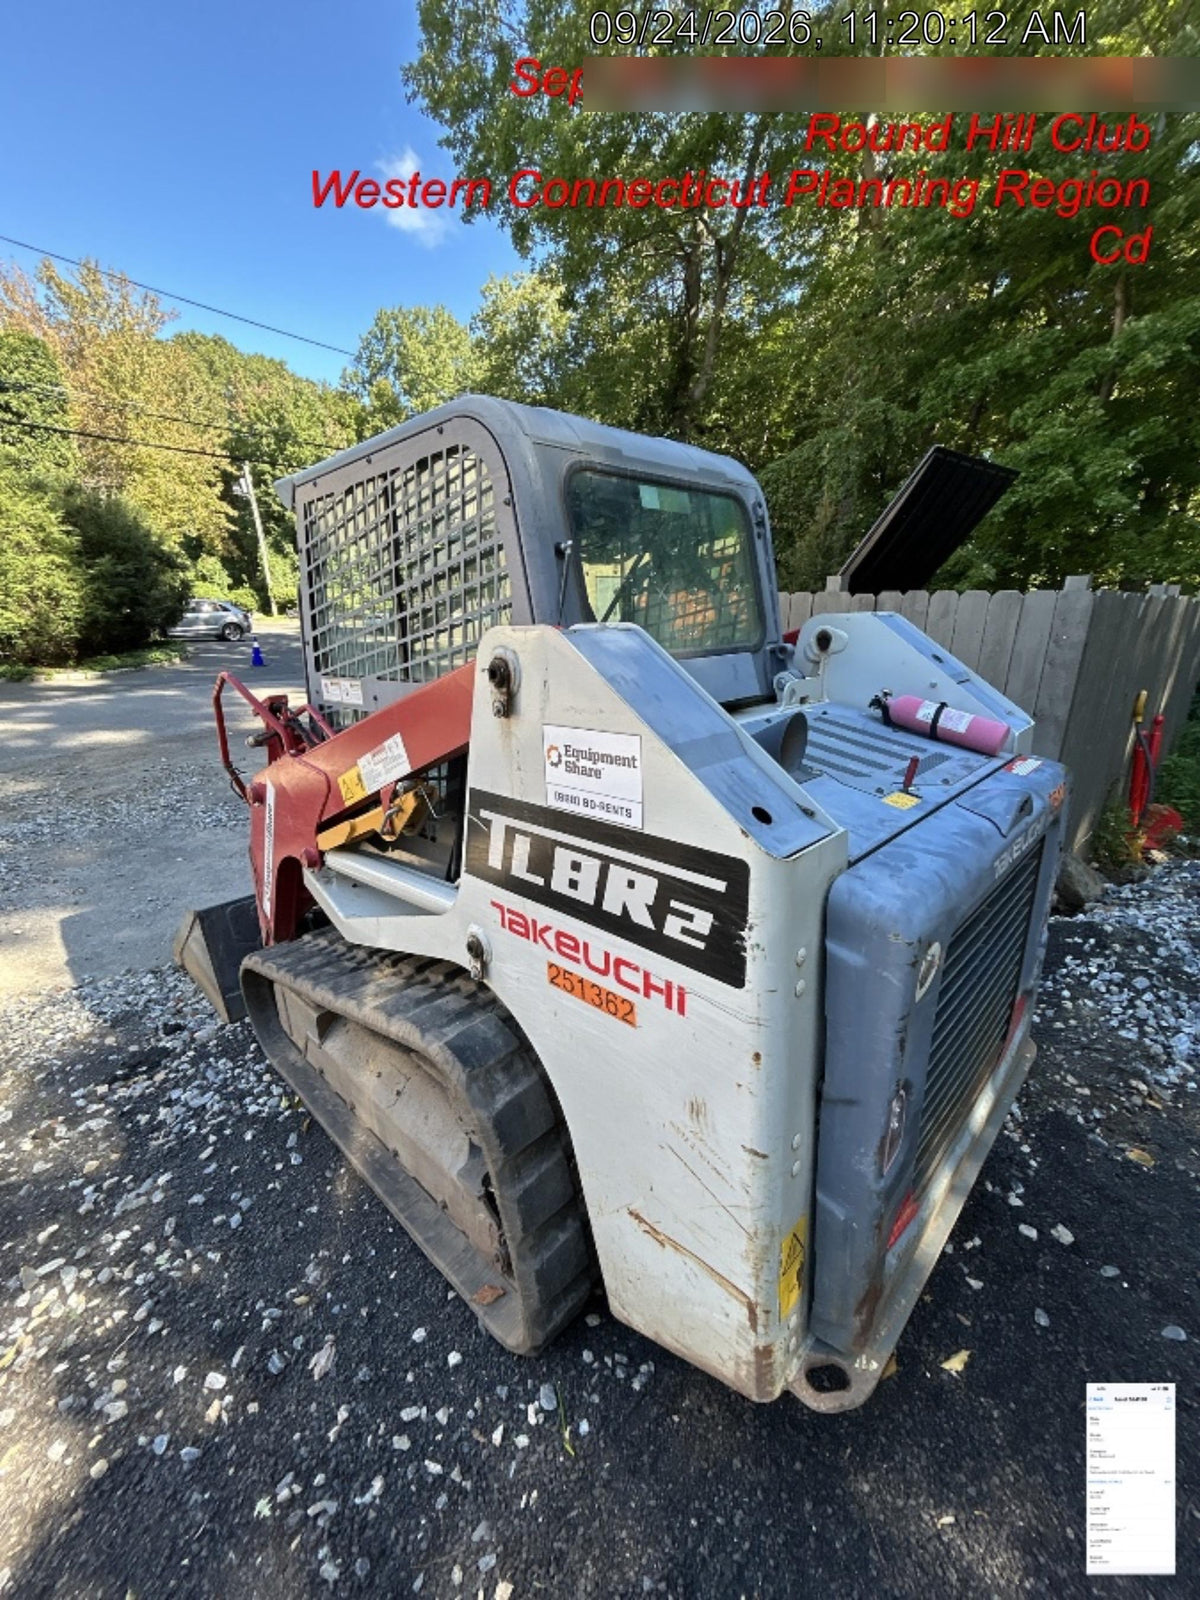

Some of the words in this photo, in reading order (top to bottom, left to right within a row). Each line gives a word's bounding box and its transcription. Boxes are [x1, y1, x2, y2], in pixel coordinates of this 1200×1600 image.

[563, 744, 638, 768] Equipment
[564, 760, 603, 780] Share
[549, 963, 636, 1022] 251362
